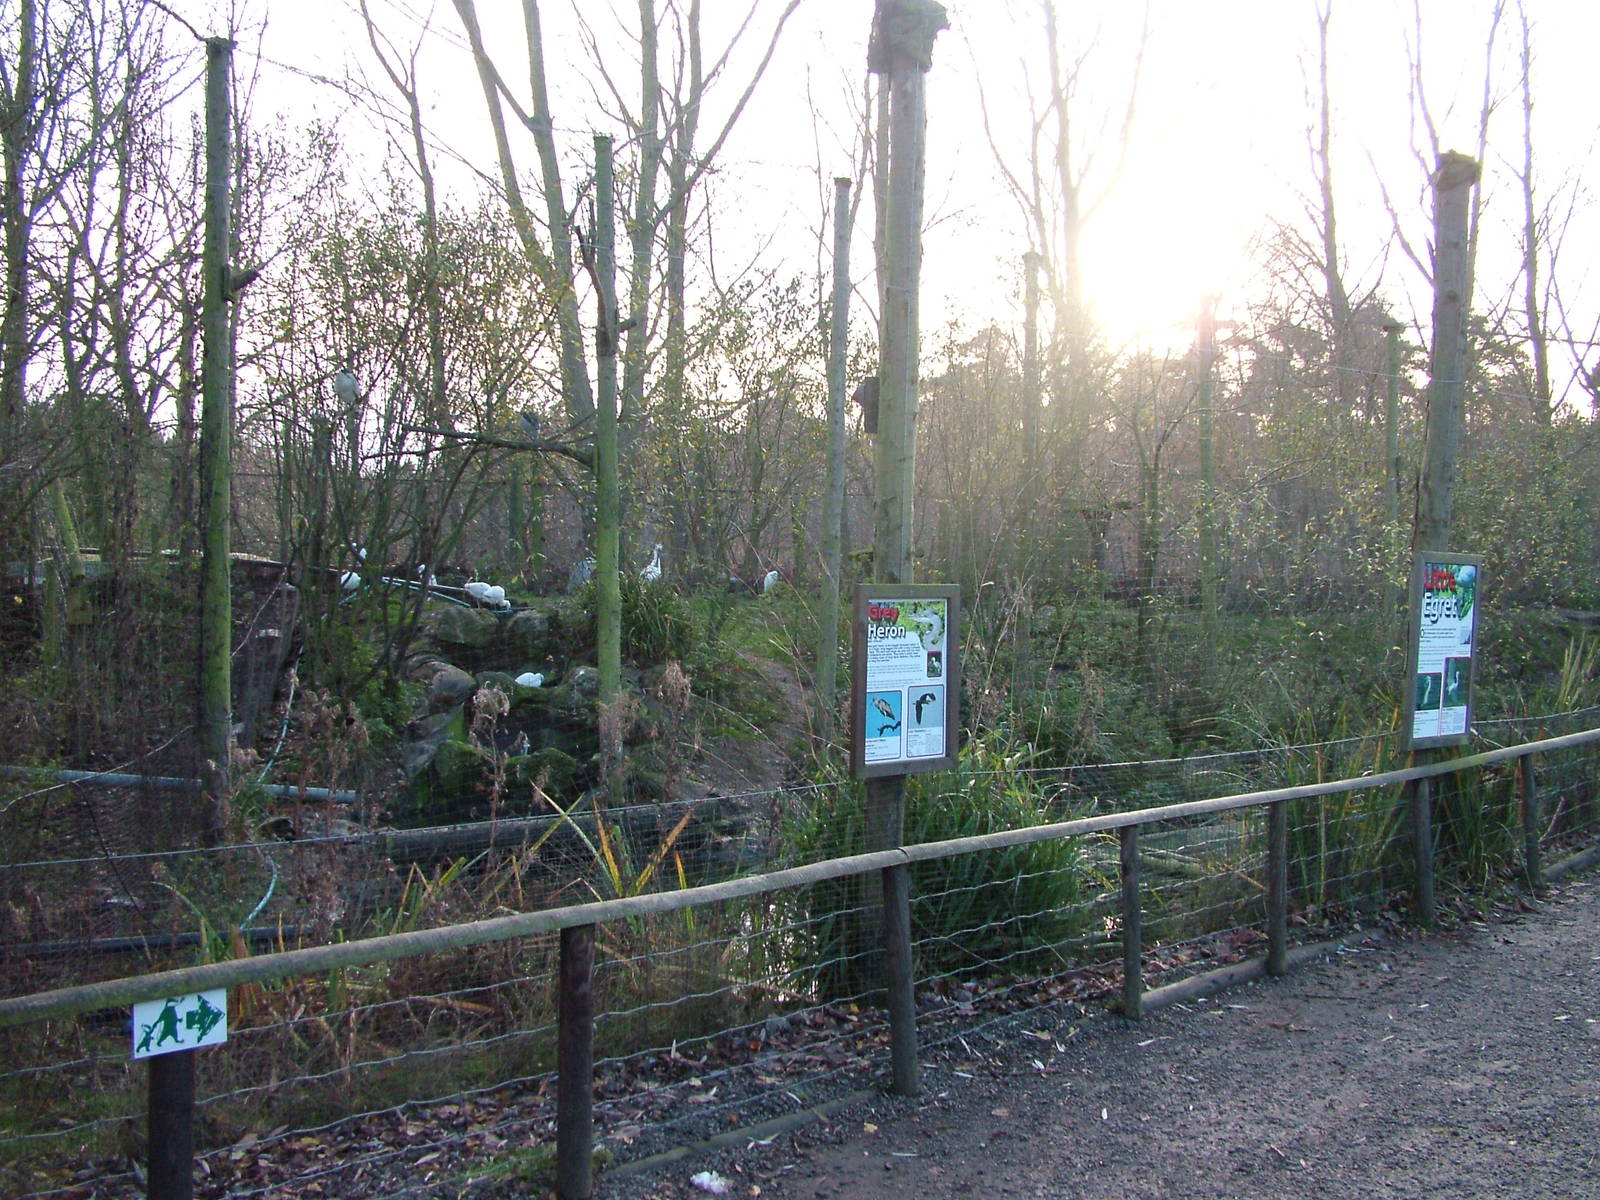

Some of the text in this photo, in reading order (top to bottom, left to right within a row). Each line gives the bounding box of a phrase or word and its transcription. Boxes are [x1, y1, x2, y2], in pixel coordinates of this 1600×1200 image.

[867, 605, 899, 623] Grey
[1424, 592, 1457, 623] Egret
[867, 623, 905, 638] Heron
